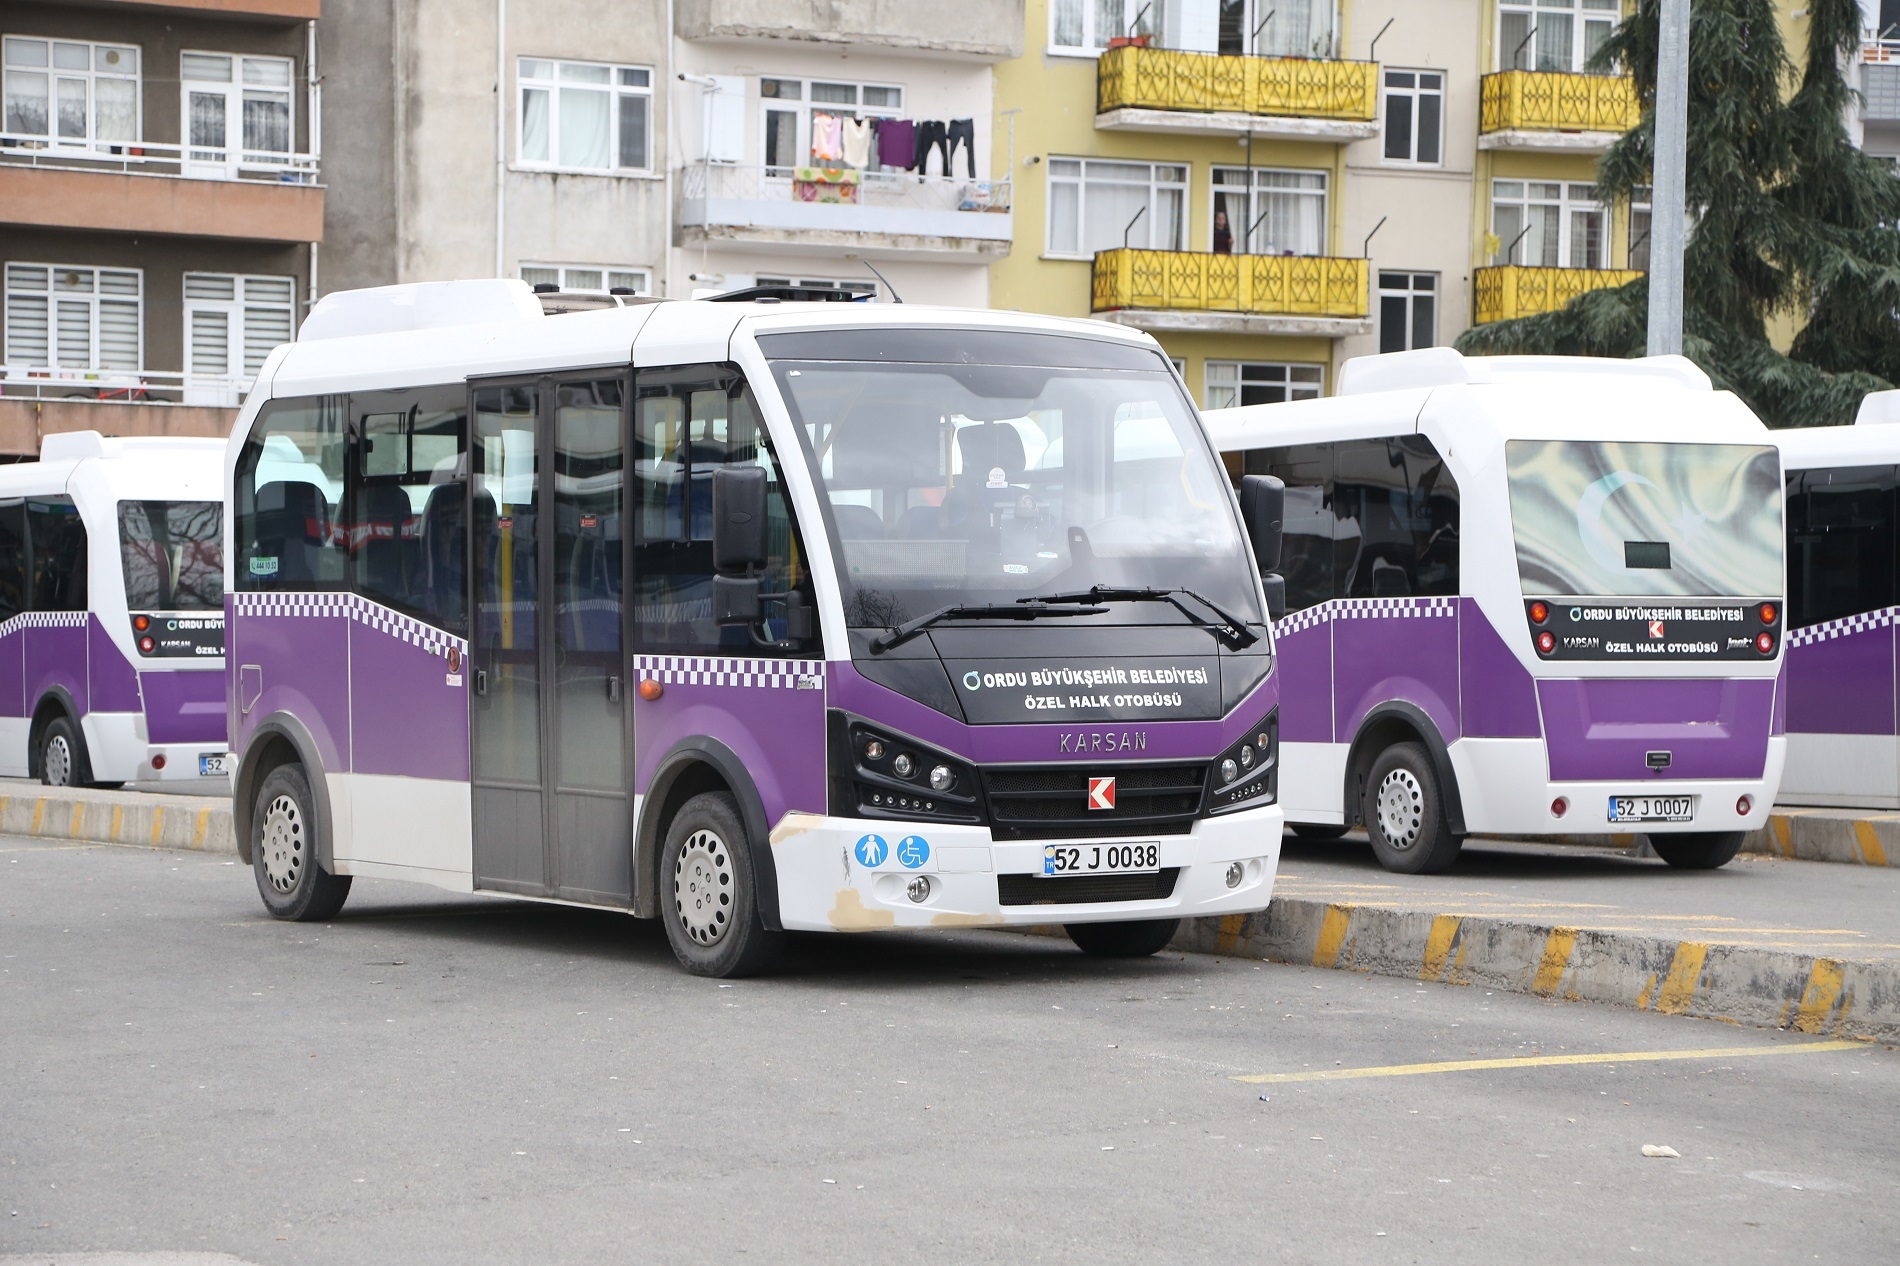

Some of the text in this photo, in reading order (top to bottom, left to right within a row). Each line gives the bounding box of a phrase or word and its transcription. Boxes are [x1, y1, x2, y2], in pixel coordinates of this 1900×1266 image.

[1583, 606, 1744, 622] ORDU BÜYÜKŞEHİR BELEDİYESİ
[178, 619, 203, 629] ORDU
[195, 645, 219, 655] ÖZEL
[1563, 637, 1600, 649] KARSAN
[1605, 641, 1719, 653] ÖZEL HALK OTOBÜSÜ
[983, 666, 1208, 688] ORDU BÜYÜKŞEHİR BELEDİYESİ
[1024, 692, 1182, 710] ÖZEL HALK OTOBÜSÜ
[1059, 731, 1147, 753] KARSAN
[207, 759, 222, 771] 52
[1617, 799, 1690, 816] 52 J 0007
[1045, 861, 1054, 869] TR
[1055, 845, 1158, 871] 52 J 0038
